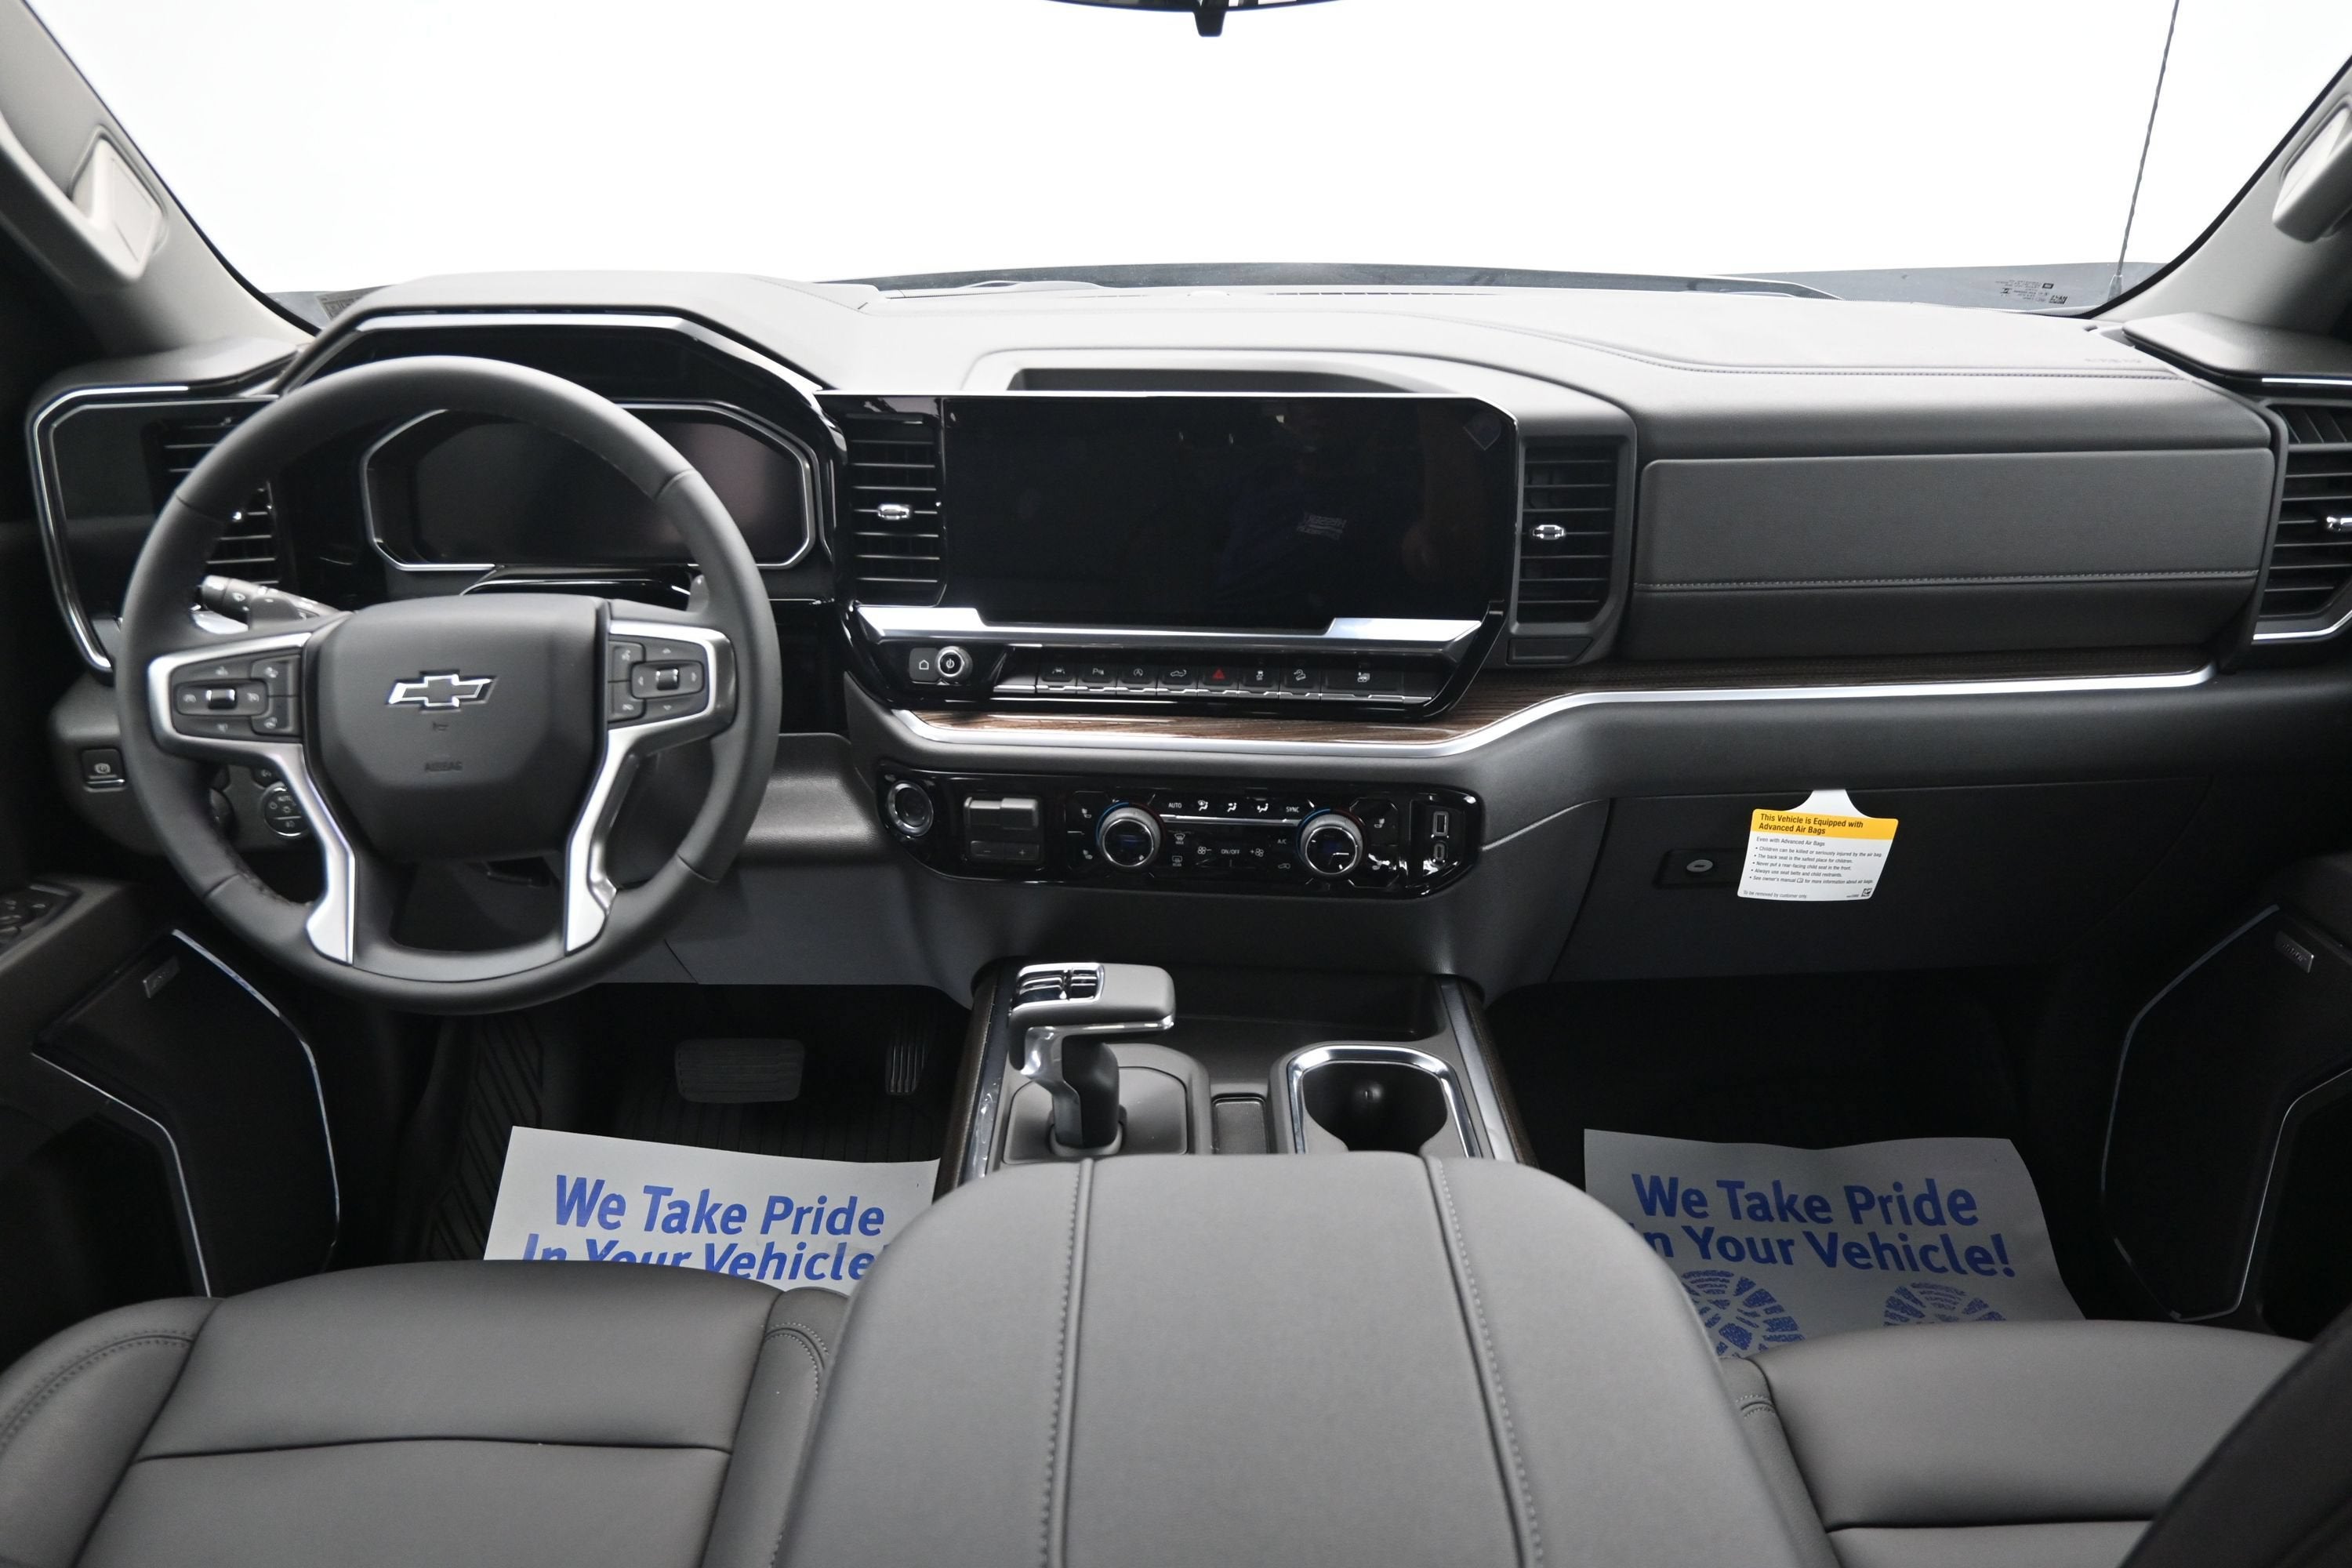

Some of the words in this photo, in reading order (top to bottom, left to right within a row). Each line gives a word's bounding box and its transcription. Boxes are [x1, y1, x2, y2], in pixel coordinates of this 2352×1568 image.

[1759, 822, 1794, 832] Advanced
[1808, 826, 1826, 836] Bags
[1760, 813, 1775, 822] This
[1777, 815, 1803, 824] Vehicle
[1813, 818, 1846, 828] Equipped
[556, 1174, 626, 1230] We
[642, 1185, 748, 1235] Take
[760, 1195, 885, 1236] Pride
[1632, 1173, 1710, 1219] We
[1716, 1179, 1834, 1225] Take
[1843, 1178, 1979, 1226] Pride
[705, 1241, 889, 1280] Vehicle
[1628, 1222, 1674, 1258] n
[1681, 1225, 1795, 1265] Your
[1802, 1231, 2016, 1277] Vehicle!
